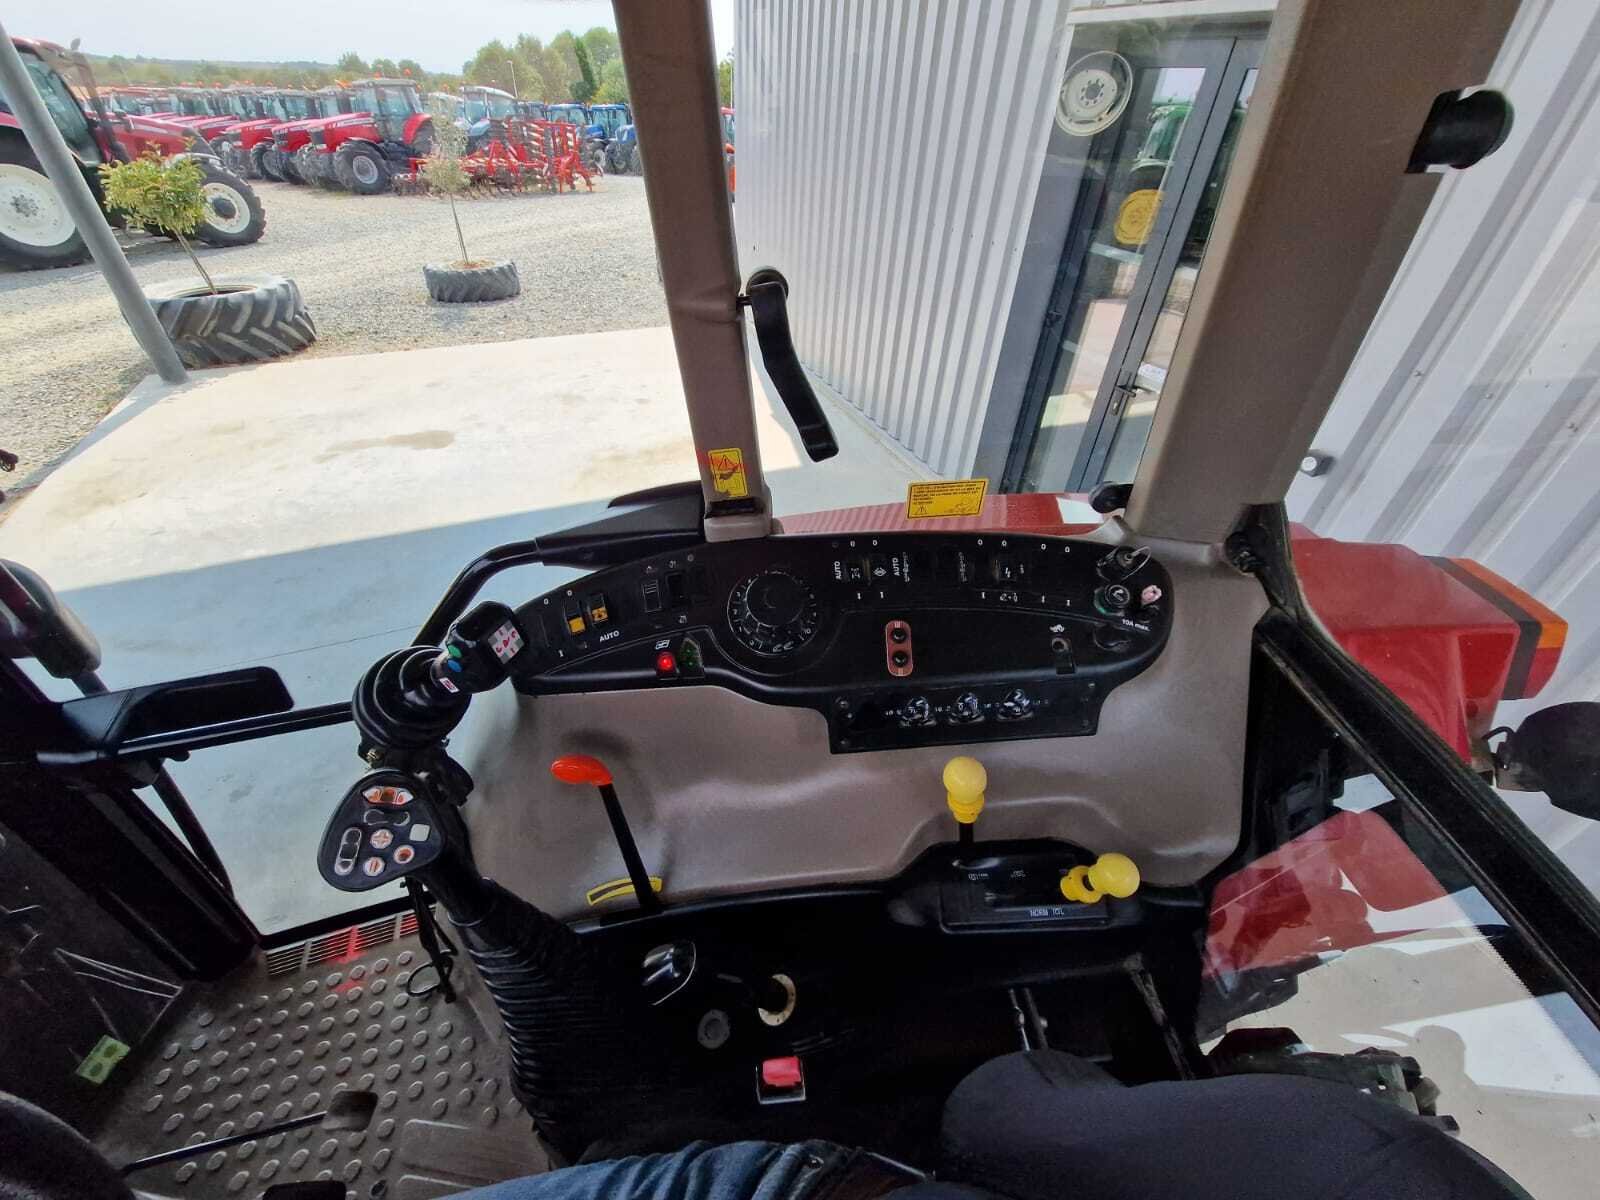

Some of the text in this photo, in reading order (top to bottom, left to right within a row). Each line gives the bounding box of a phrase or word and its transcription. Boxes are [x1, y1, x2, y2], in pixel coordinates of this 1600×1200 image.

[834, 561, 842, 580] AUTO
[892, 557, 900, 577] AUTO
[599, 630, 620, 642] AUTO
